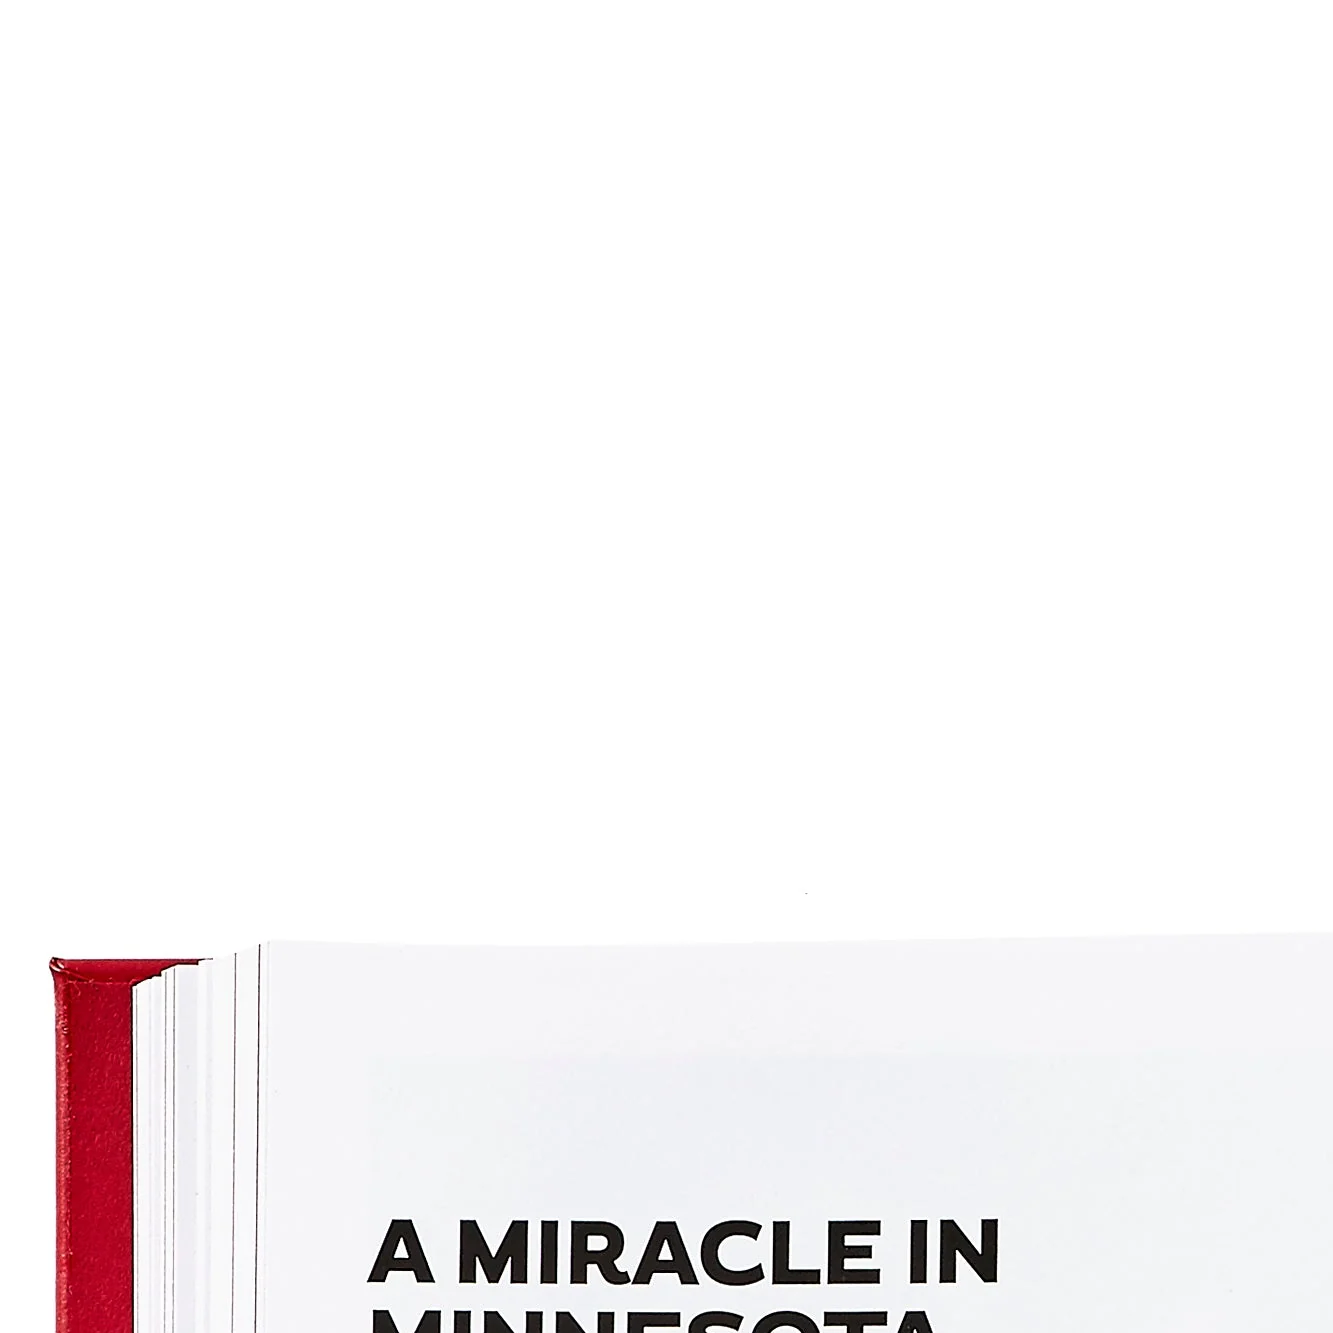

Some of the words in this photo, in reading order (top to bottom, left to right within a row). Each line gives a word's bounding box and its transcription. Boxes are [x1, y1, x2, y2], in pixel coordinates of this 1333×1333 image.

[366, 1218, 436, 1284] A
[458, 1219, 882, 1287] MIRACLE
[909, 1218, 999, 1285] IN
